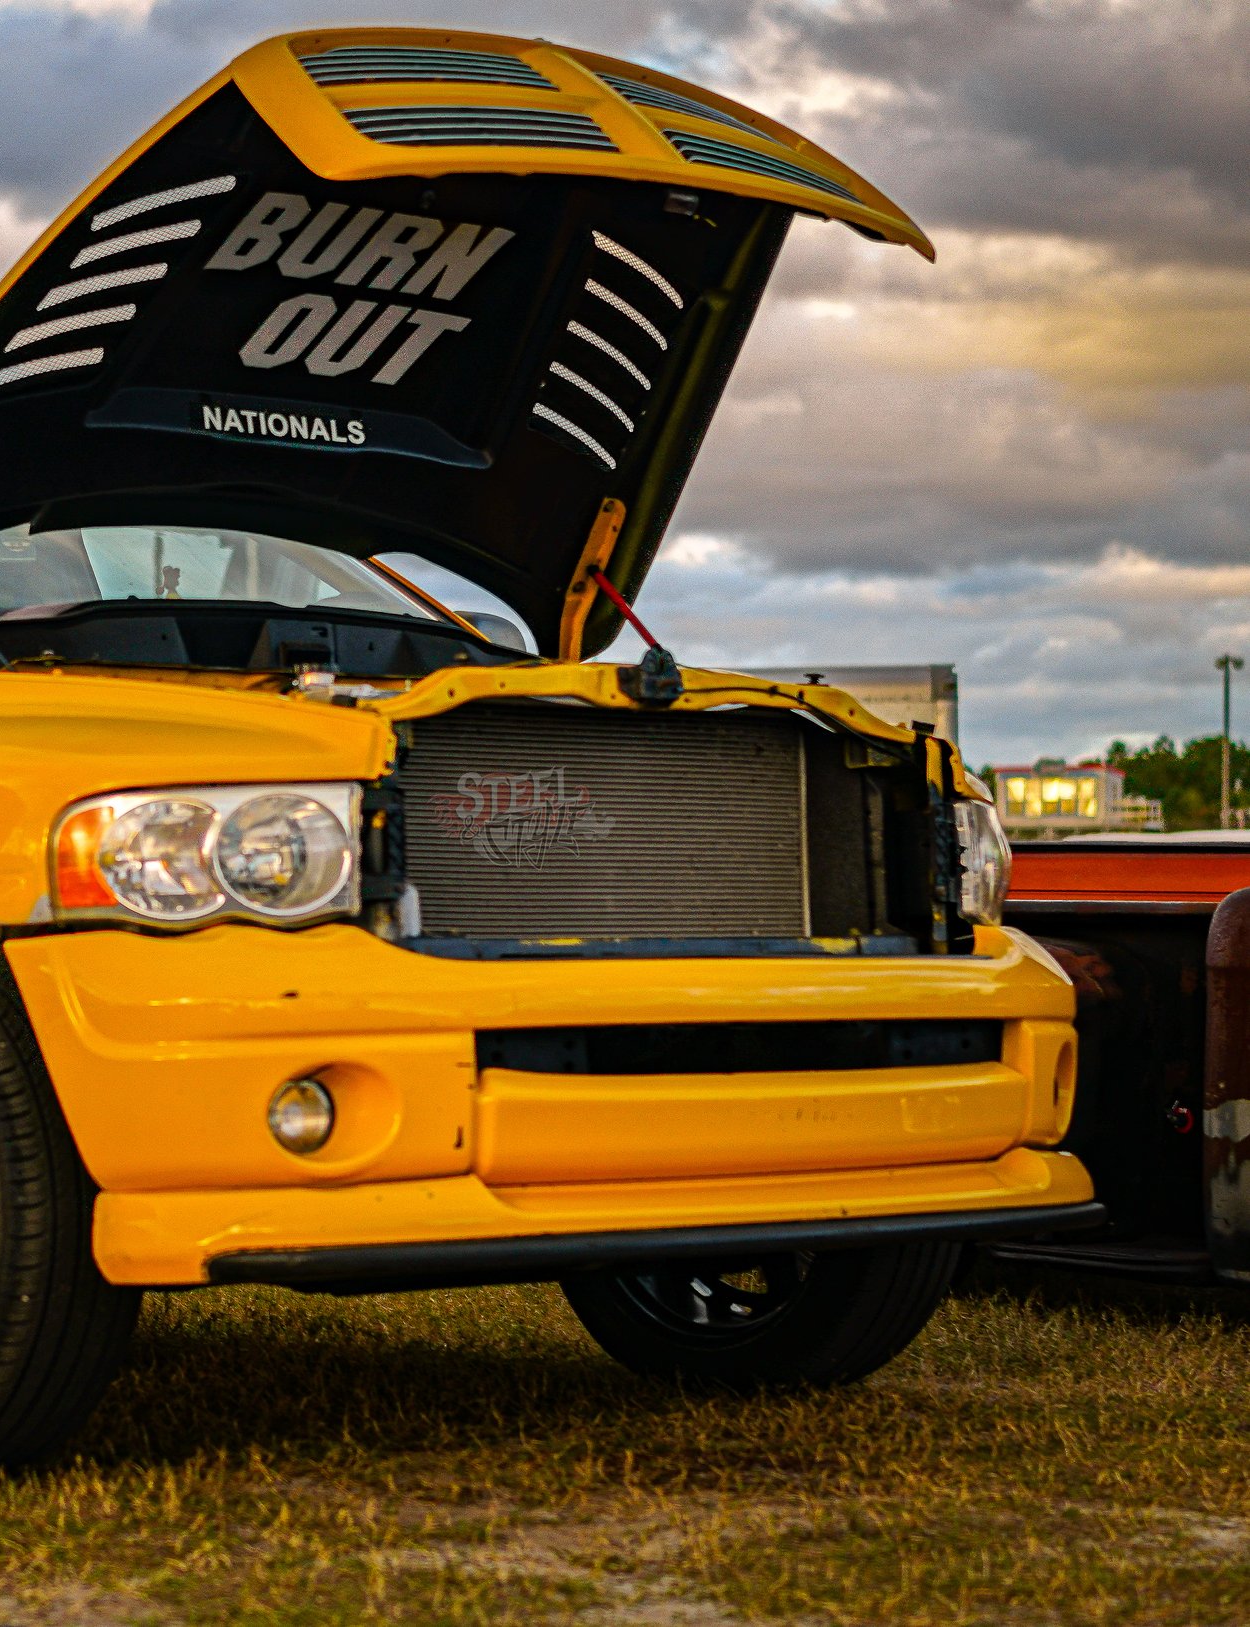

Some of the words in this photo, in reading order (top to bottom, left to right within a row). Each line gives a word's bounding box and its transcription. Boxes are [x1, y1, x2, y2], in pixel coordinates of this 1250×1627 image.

[204, 192, 516, 301] BURN
[238, 293, 472, 385] OUT
[202, 406, 366, 445] NATIONALS
